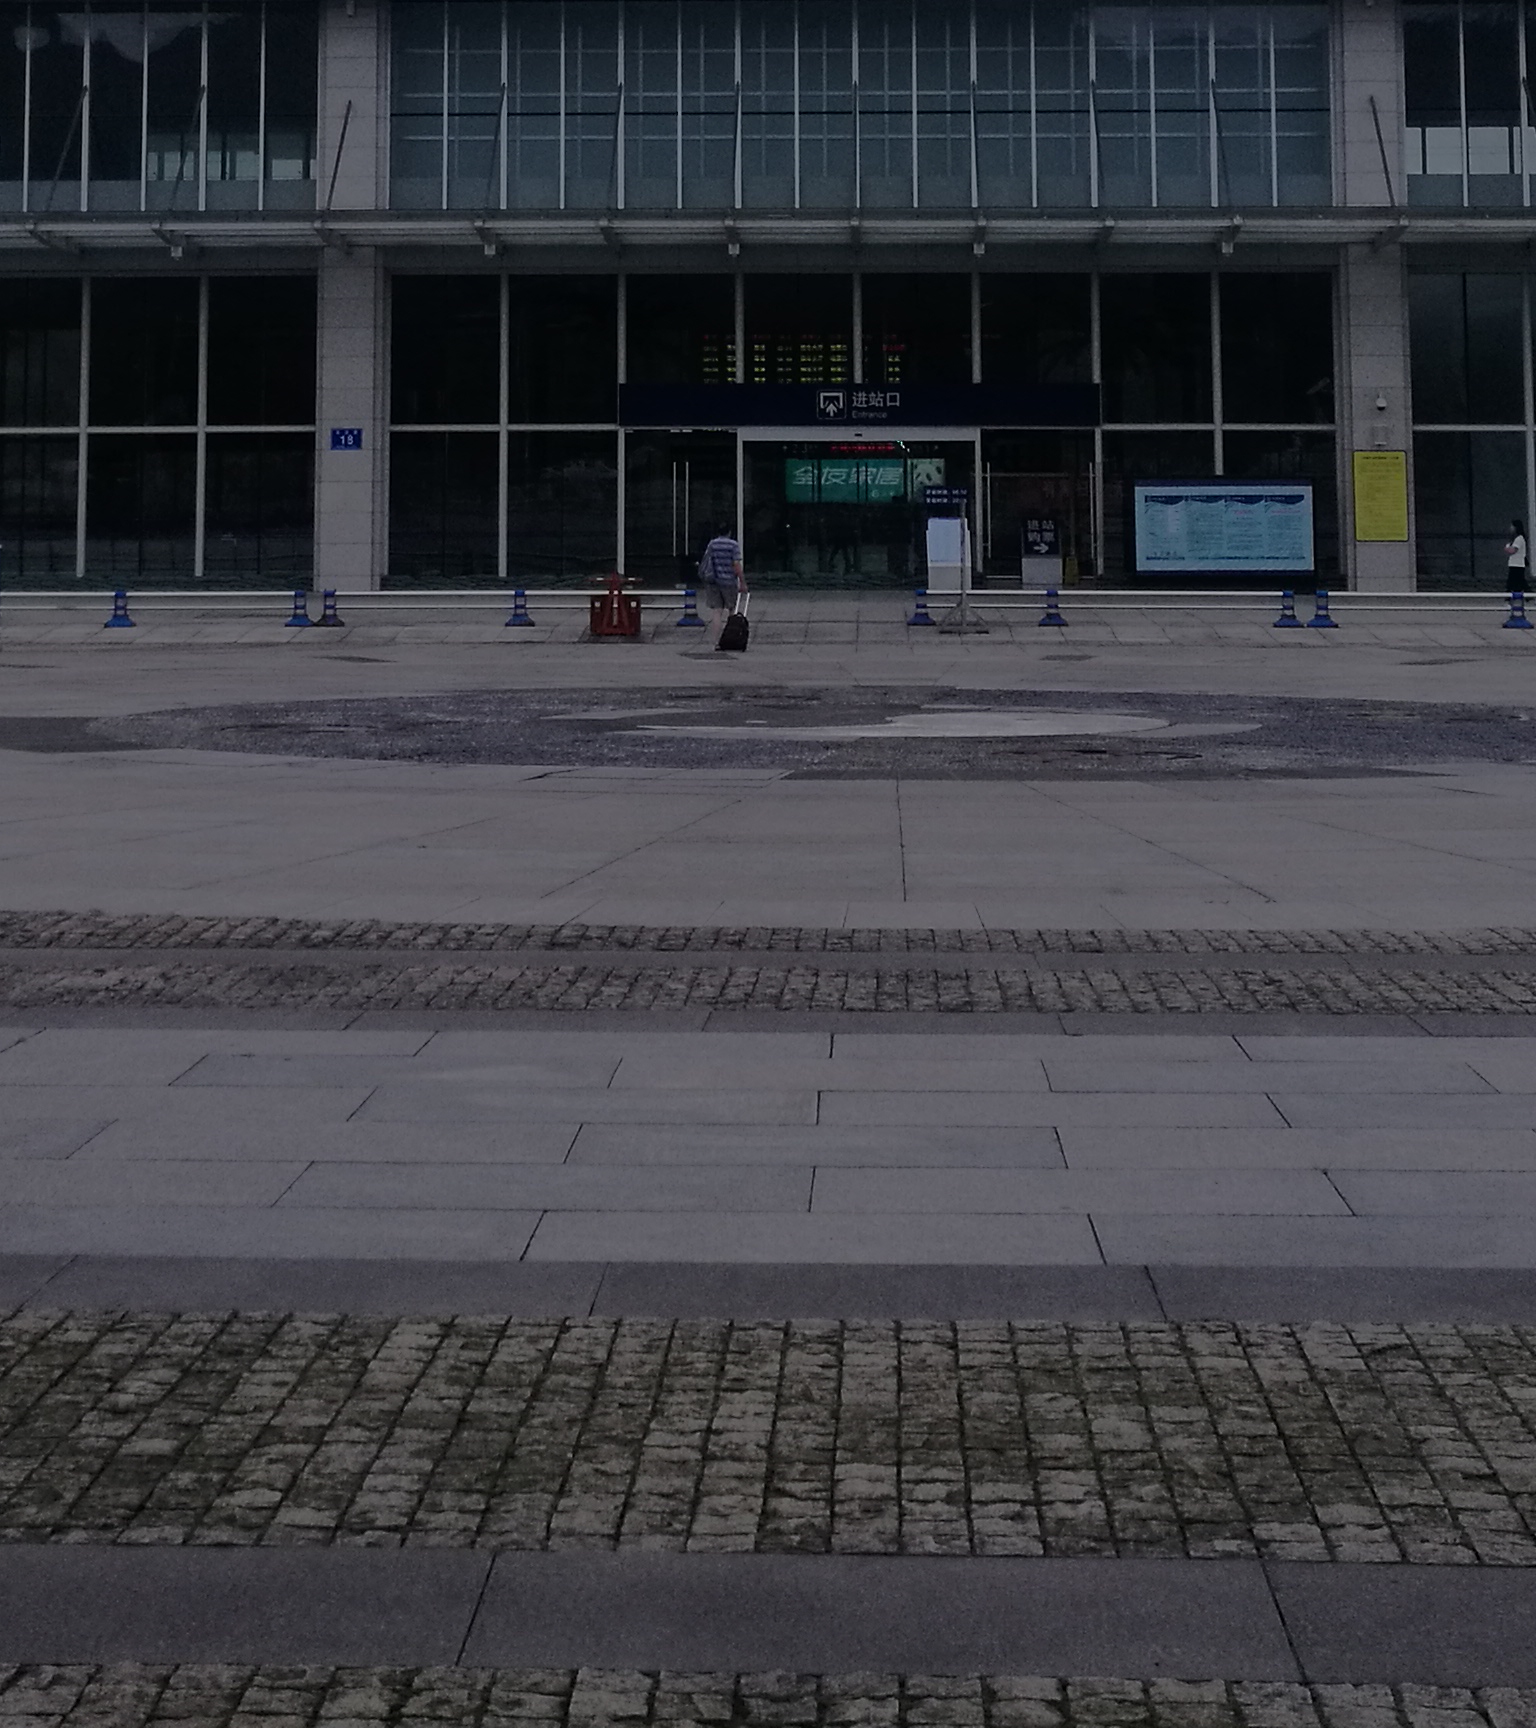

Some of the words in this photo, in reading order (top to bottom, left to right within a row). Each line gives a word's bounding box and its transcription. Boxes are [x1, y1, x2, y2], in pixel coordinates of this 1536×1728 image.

[851, 391, 901, 408] 进站口
[851, 409, 888, 419] Entrance
